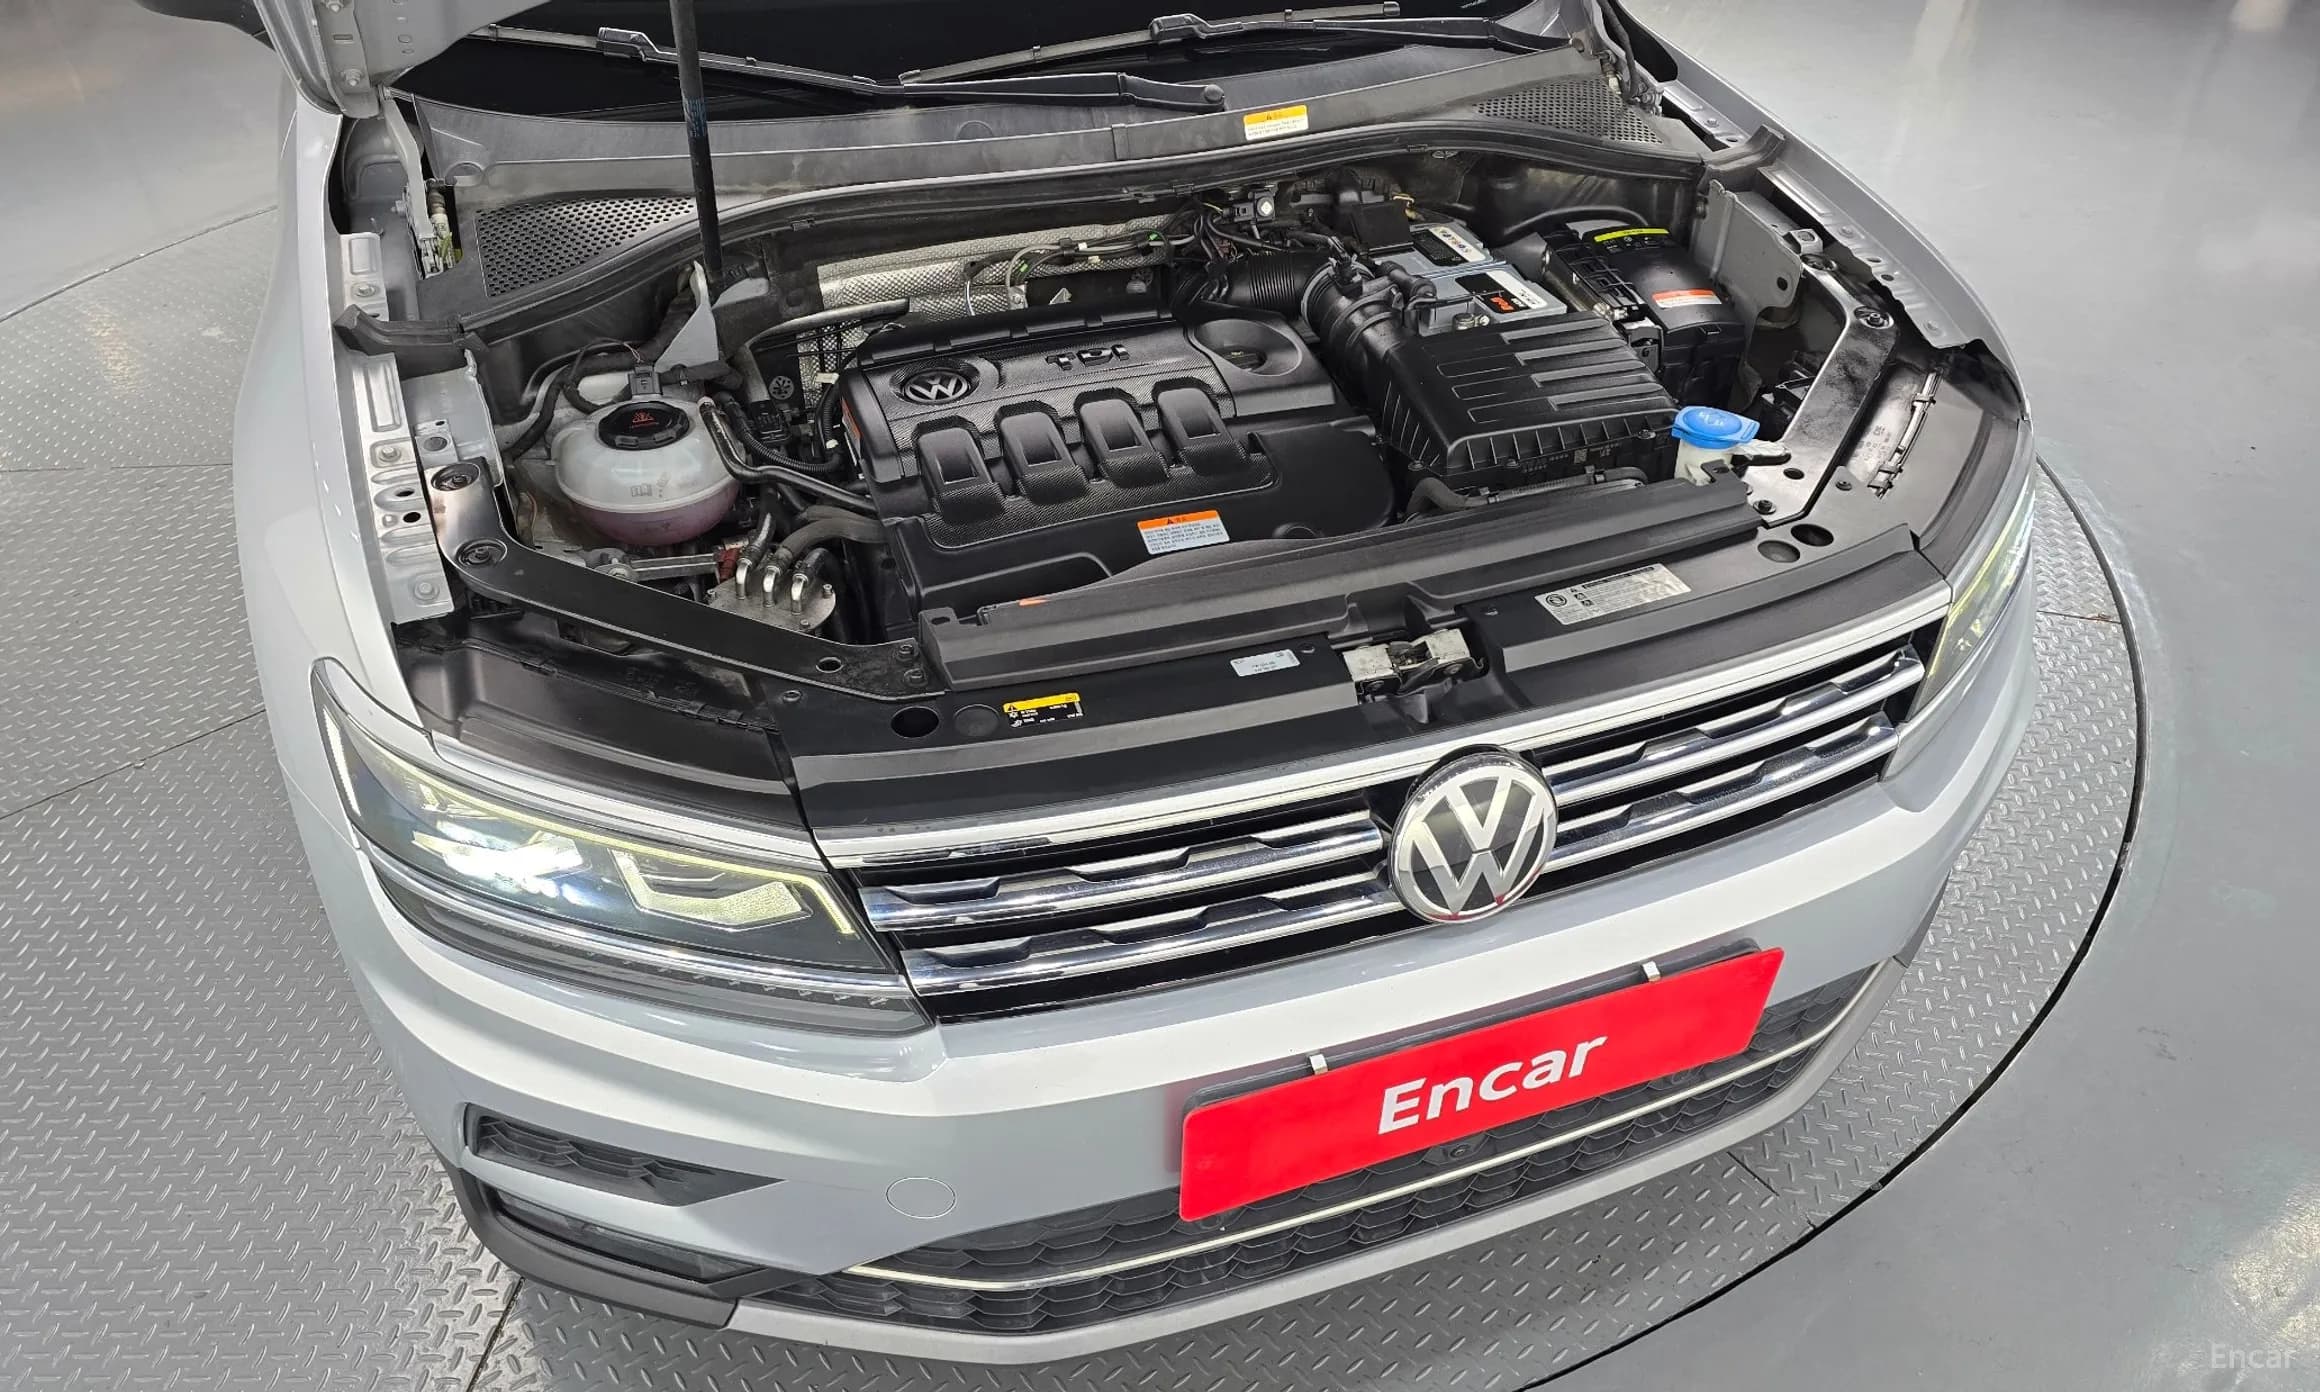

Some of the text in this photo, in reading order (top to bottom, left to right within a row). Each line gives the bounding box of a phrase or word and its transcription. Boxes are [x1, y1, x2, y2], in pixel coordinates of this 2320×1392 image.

[1045, 344, 1130, 371] TDI
[1395, 764, 1557, 923] VW
[1377, 1035, 1608, 1135] Encar
